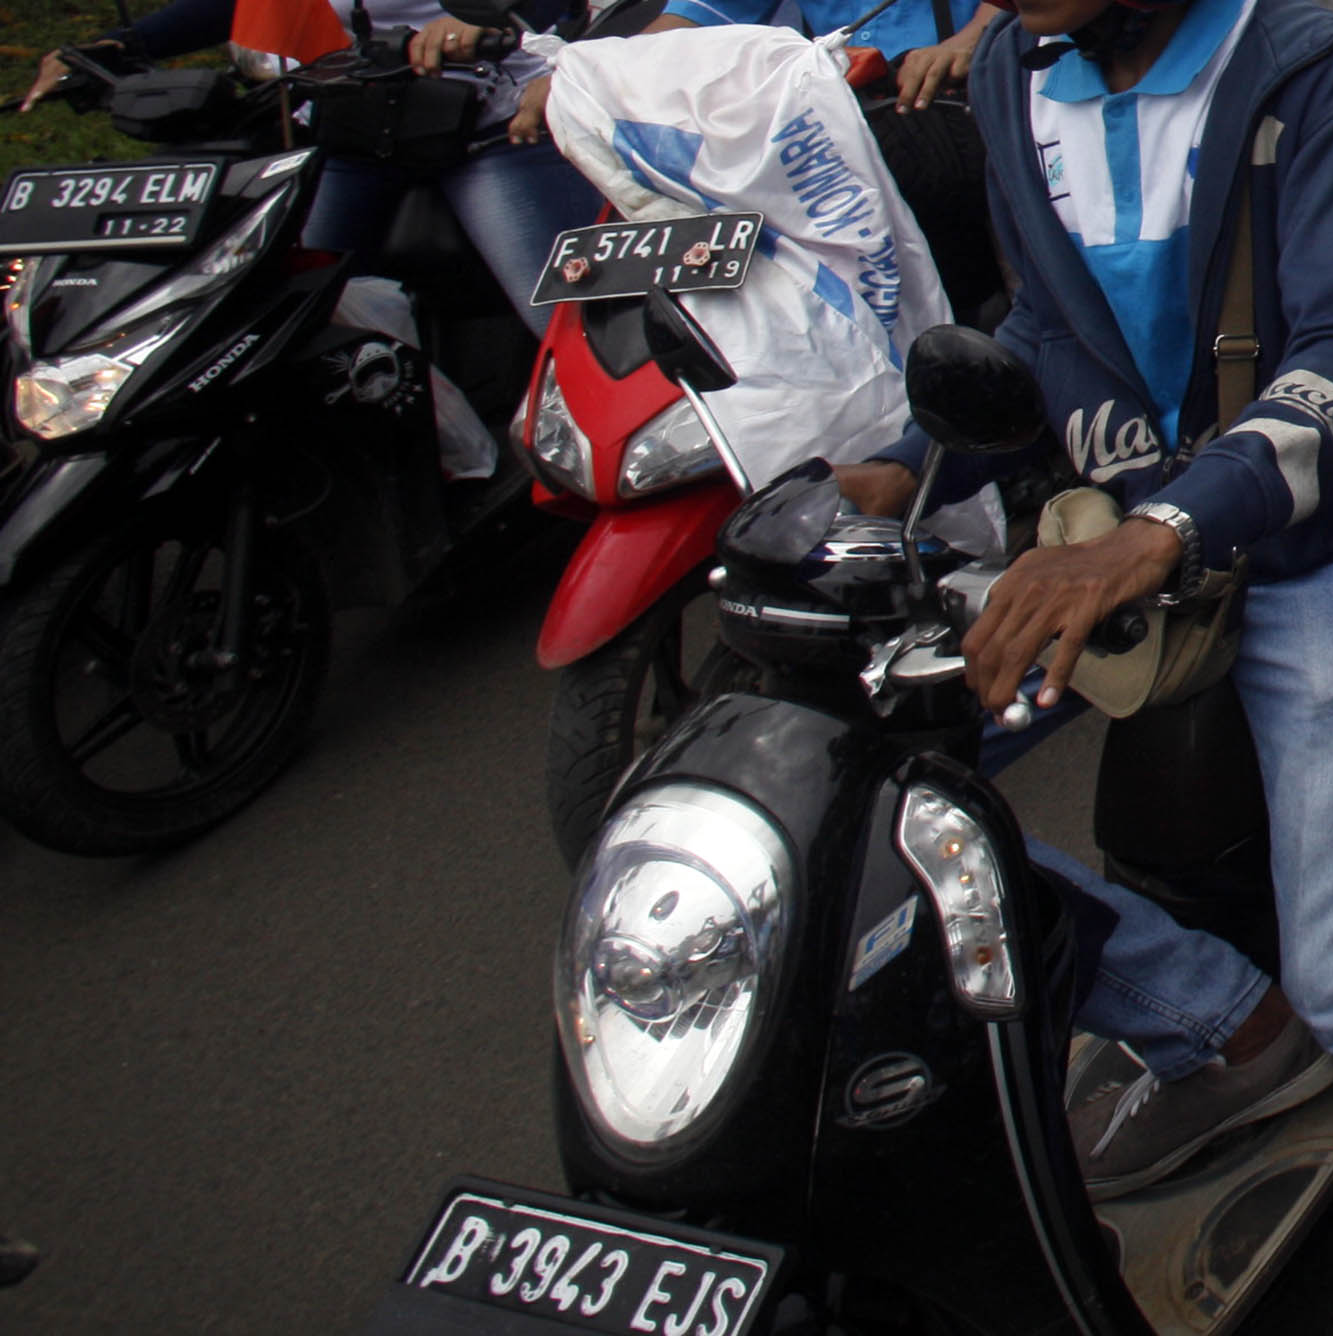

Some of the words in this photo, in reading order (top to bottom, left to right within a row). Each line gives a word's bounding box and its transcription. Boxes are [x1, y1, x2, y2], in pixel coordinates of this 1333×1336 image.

[8, 181, 35, 211] B
[52, 175, 136, 209] 3294
[139, 170, 210, 205] ELM
[555, 237, 580, 268] F
[594, 226, 673, 262] 5741
[709, 220, 753, 252] LR
[187, 332, 260, 393] HONDA
[1066, 399, 1159, 476] Ma
[422, 1215, 490, 1288] B
[491, 1225, 630, 1318] 3943
[630, 1260, 749, 1336] EJS
